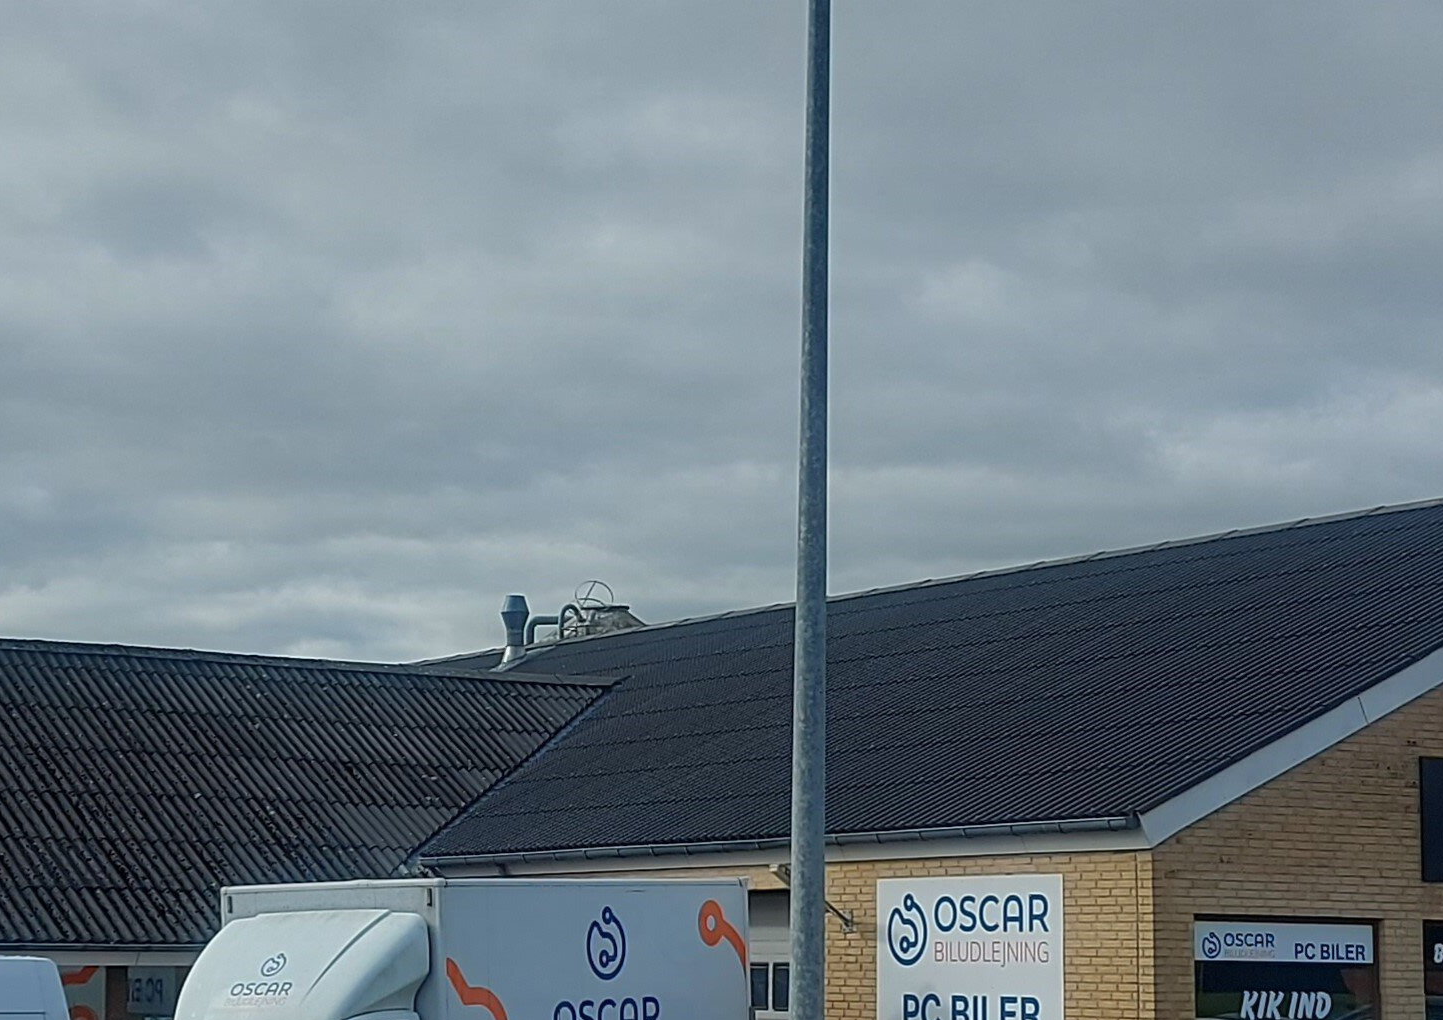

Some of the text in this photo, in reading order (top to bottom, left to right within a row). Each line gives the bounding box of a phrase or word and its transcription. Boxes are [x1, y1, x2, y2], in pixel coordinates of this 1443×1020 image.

[934, 894, 1049, 932] OSCAR
[1223, 933, 1275, 947] OSCAR
[934, 941, 1049, 967] BILUDLEJNING
[1294, 943, 1366, 960] PC BILER
[230, 982, 293, 997] OSCAR
[1240, 990, 1332, 1020] KIK IND
